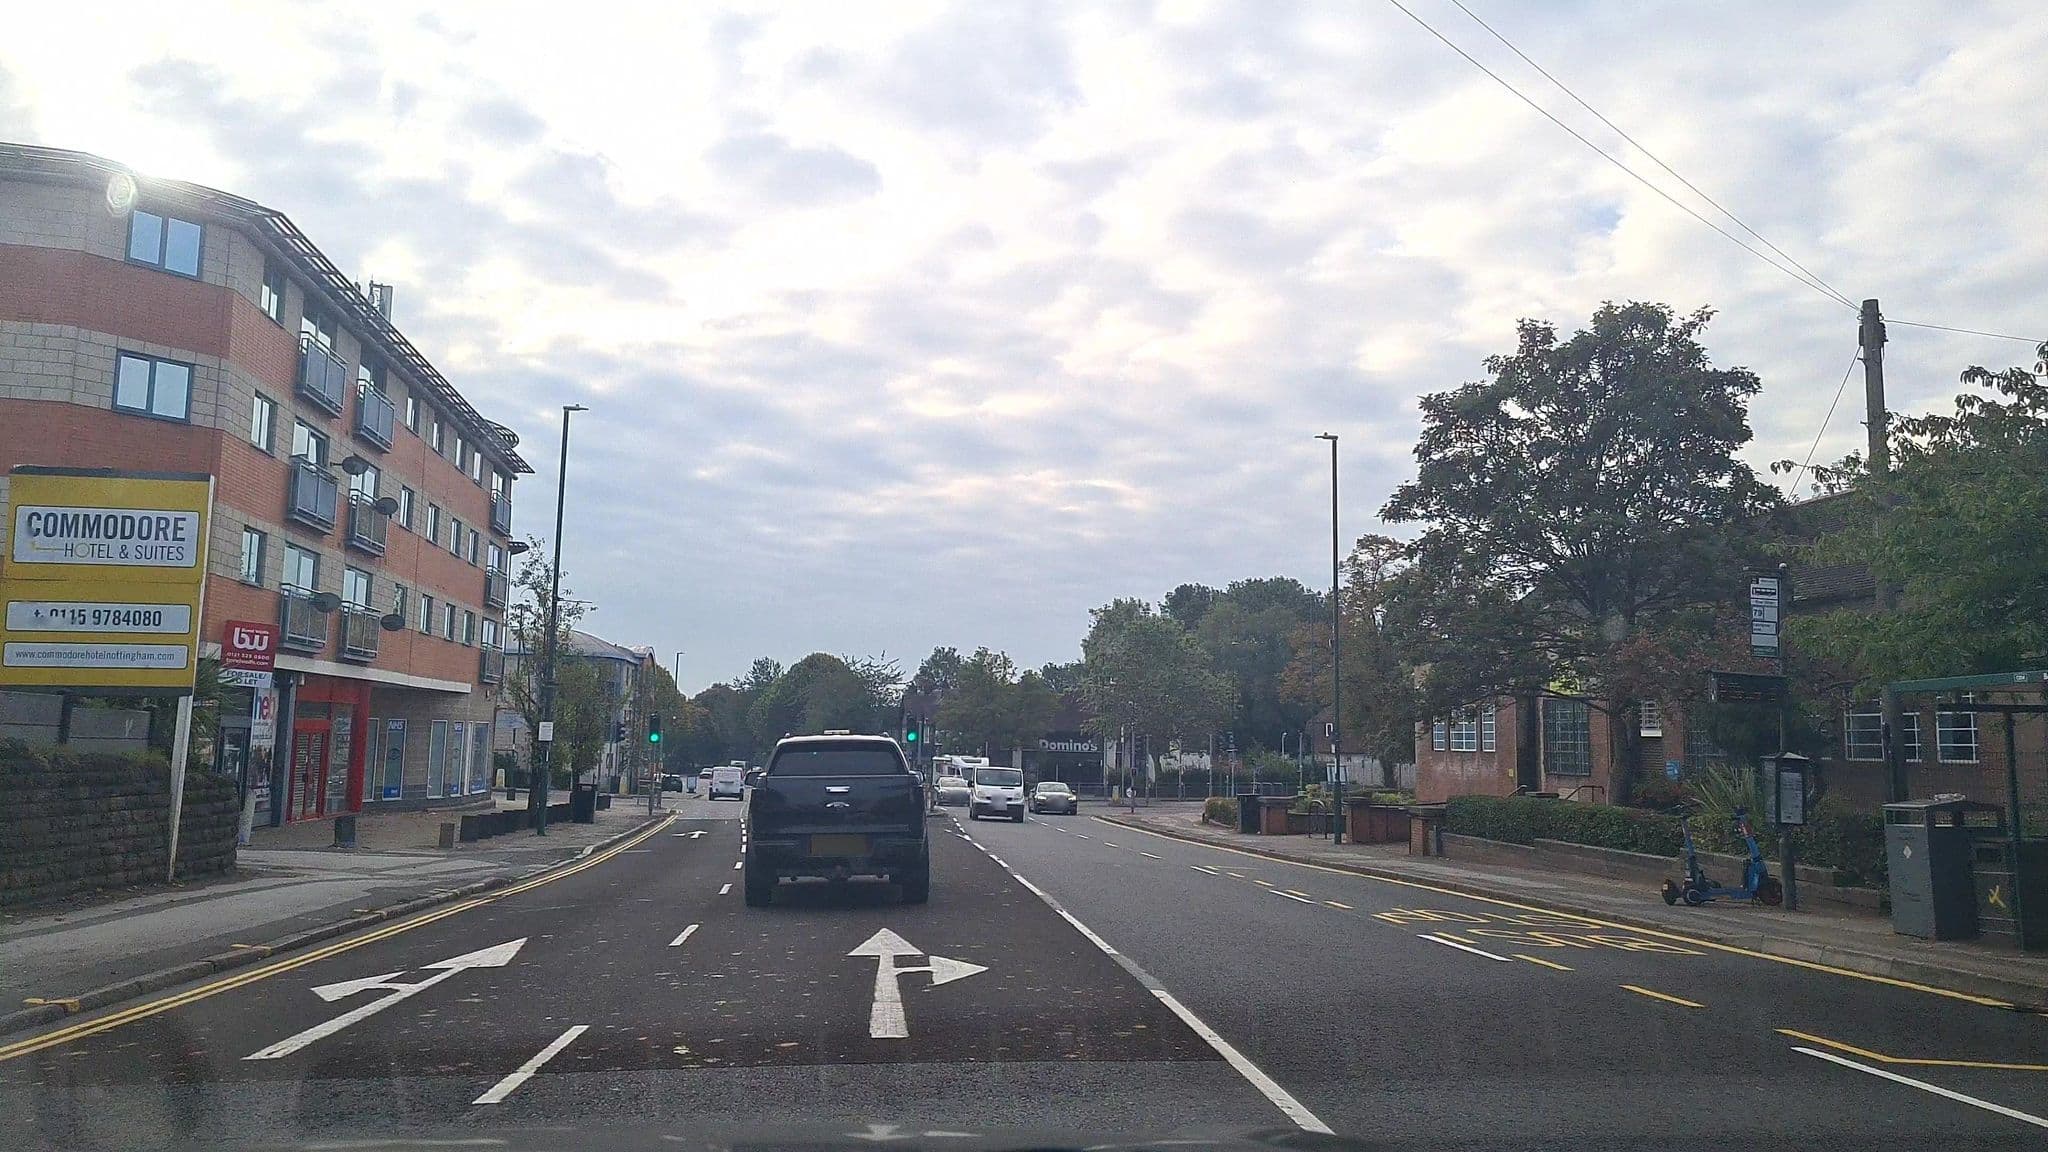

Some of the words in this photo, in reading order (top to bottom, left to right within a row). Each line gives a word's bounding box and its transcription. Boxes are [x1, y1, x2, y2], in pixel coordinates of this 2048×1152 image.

[27, 511, 187, 542] COMMODORE
[64, 542, 114, 559] HOTEL
[119, 544, 129, 559] &
[134, 544, 184, 561] SUITES
[92, 609, 162, 627] 9784080
[388, 721, 404, 730] NHS
[1039, 739, 1098, 751] Domino's
[1371, 907, 1602, 929] STOP
[1467, 929, 1708, 956] BUS
